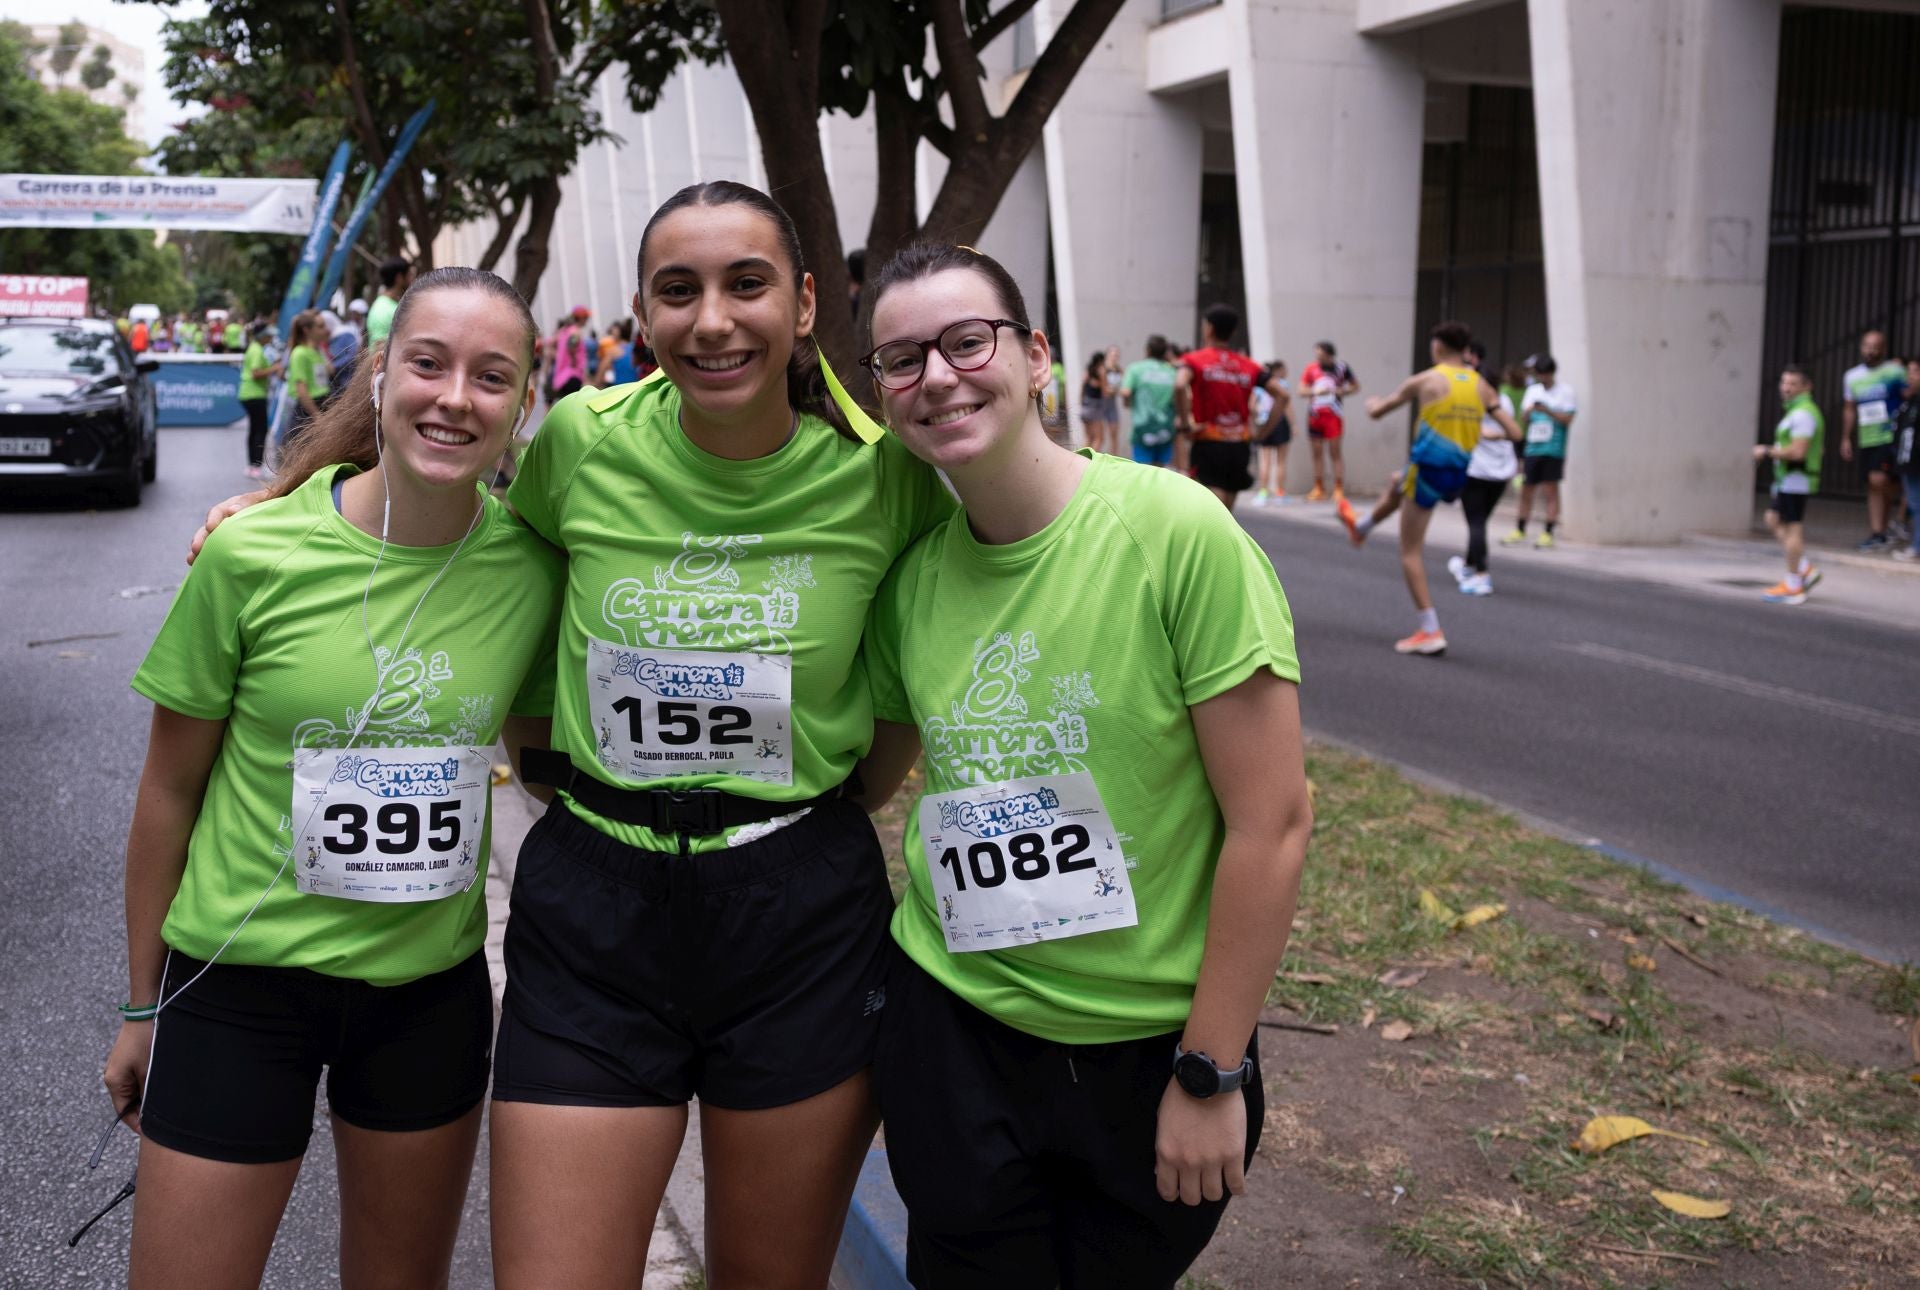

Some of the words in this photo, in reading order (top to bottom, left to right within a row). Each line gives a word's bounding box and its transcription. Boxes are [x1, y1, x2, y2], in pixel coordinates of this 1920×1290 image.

[18, 180, 92, 194] Carrera
[98, 181, 121, 194] de
[129, 182, 145, 195] la
[152, 183, 217, 195] Prensa
[611, 587, 765, 622] Carrera
[767, 590, 794, 607] de
[770, 607, 795, 624] la
[638, 660, 725, 683] Carrera
[726, 664, 742, 675] de
[729, 675, 743, 685] la
[656, 681, 732, 700] Prensa
[611, 696, 753, 745] 152
[451, 732, 474, 747] de
[928, 725, 1057, 758] Carrera
[1056, 716, 1082, 732] de
[1063, 732, 1086, 749] la
[634, 750, 663, 760] CASADO
[665, 752, 707, 761] BERROCAL,
[709, 752, 734, 760] PAULA
[361, 761, 444, 782] Carrera
[444, 758, 457, 769] de
[447, 769, 457, 778] la
[378, 780, 448, 796] Prensa
[959, 795, 1042, 825] Carrera
[1041, 789, 1054, 798] de
[322, 800, 461, 854] 395
[976, 808, 1052, 836] Prensa
[345, 861, 384, 872] GONZÁLEZ
[386, 862, 426, 871] CAMACHO,
[429, 859, 449, 869] LAURA
[939, 824, 1096, 891] 1082
